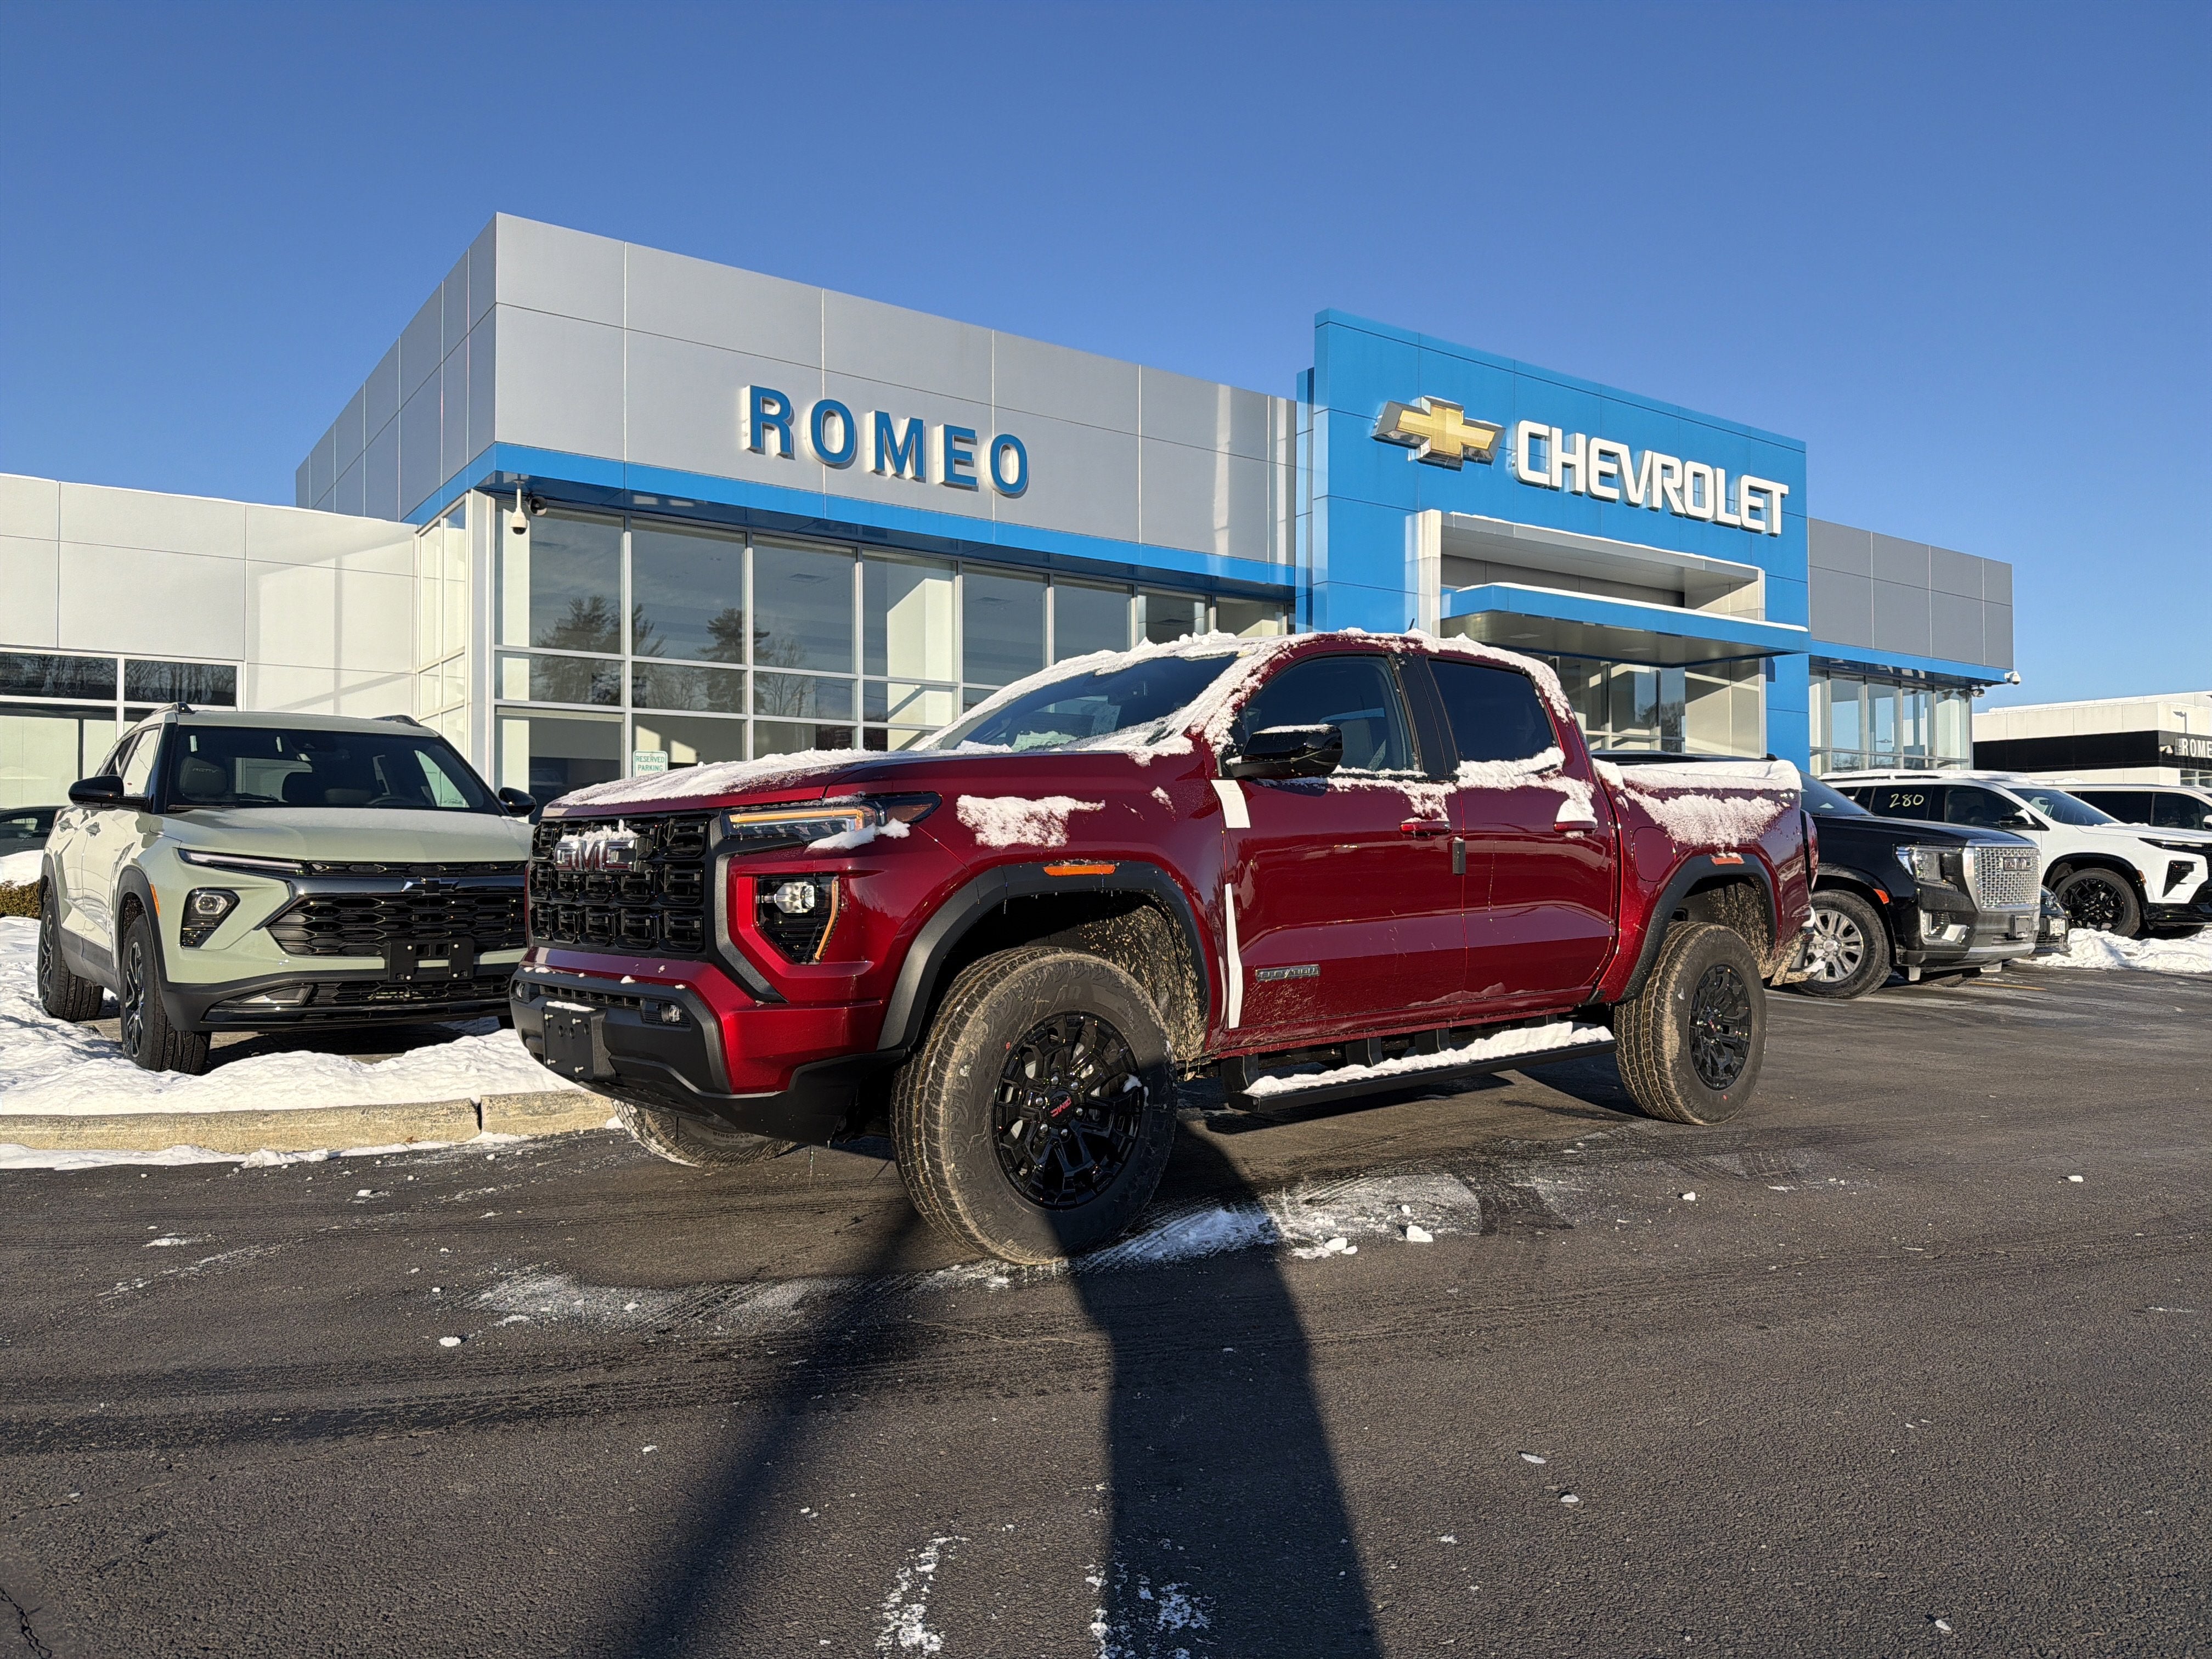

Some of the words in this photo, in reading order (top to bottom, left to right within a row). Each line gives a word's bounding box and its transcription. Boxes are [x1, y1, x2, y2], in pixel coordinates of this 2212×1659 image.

[744, 385, 1028, 494] ROMEO
[1516, 420, 1788, 535] CHEVROLET
[1889, 793, 1924, 808] 280
[554, 839, 636, 872] GMC
